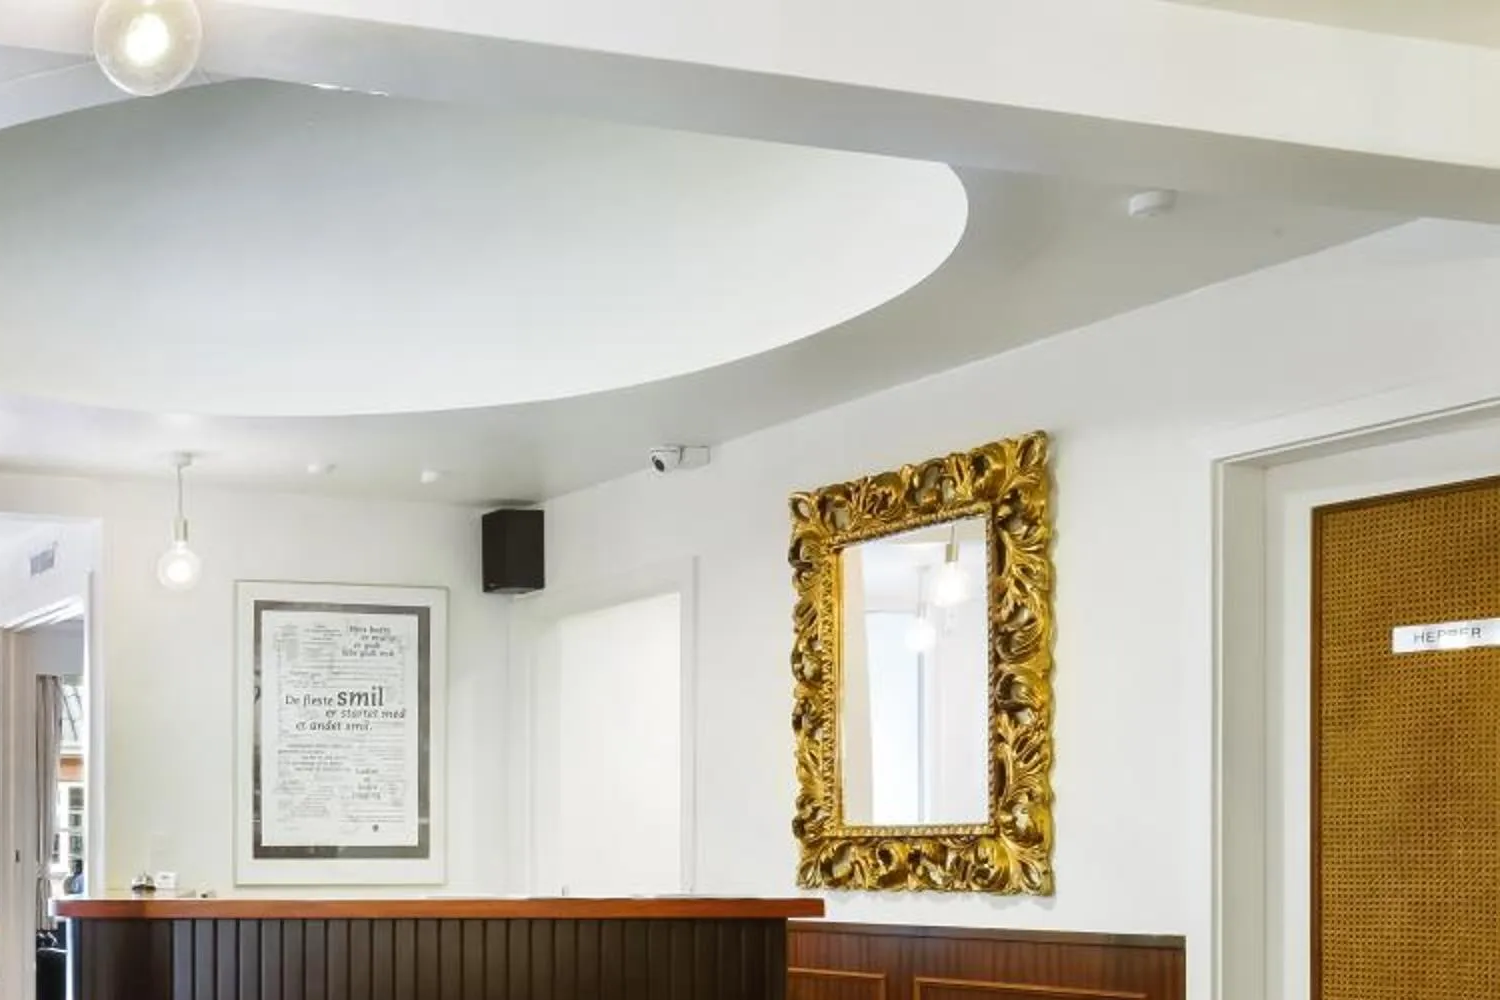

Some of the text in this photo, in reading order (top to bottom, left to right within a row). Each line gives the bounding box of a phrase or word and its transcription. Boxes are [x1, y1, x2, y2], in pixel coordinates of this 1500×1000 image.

[303, 693, 334, 708] fleste
[337, 685, 384, 707] smil
[381, 708, 406, 718] med
[309, 720, 341, 731] andet
